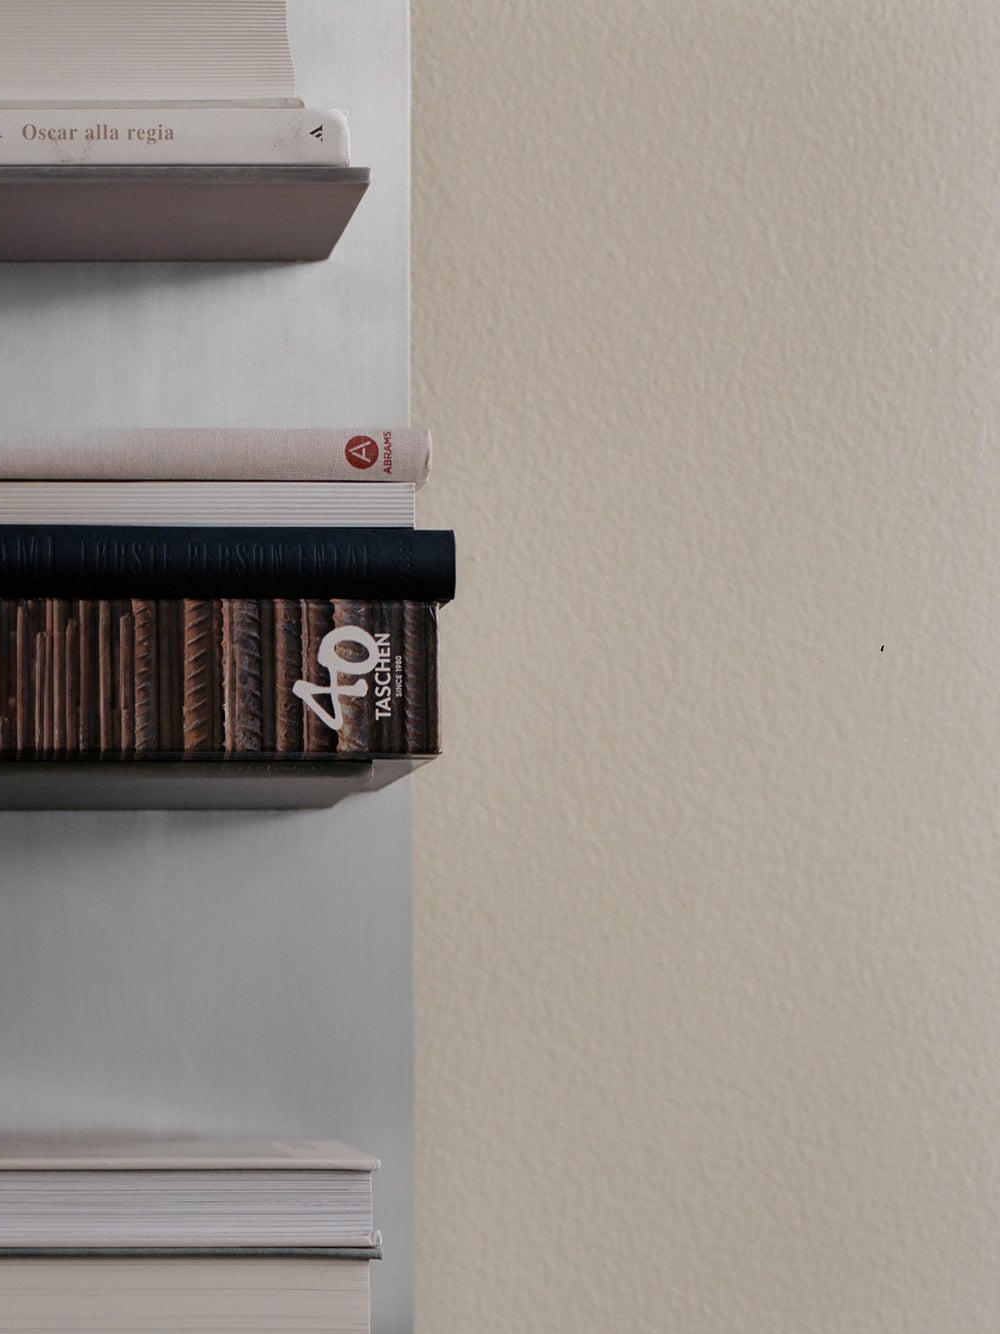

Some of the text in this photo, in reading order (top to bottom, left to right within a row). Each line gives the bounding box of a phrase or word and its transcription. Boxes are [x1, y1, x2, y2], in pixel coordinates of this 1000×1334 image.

[22, 123, 78, 141] Oscar
[84, 123, 119, 141] alla
[127, 124, 175, 145] regia
[383, 431, 392, 475] ABRAMS
[292, 625, 379, 730] 40
[375, 633, 391, 721] TASCHEN
